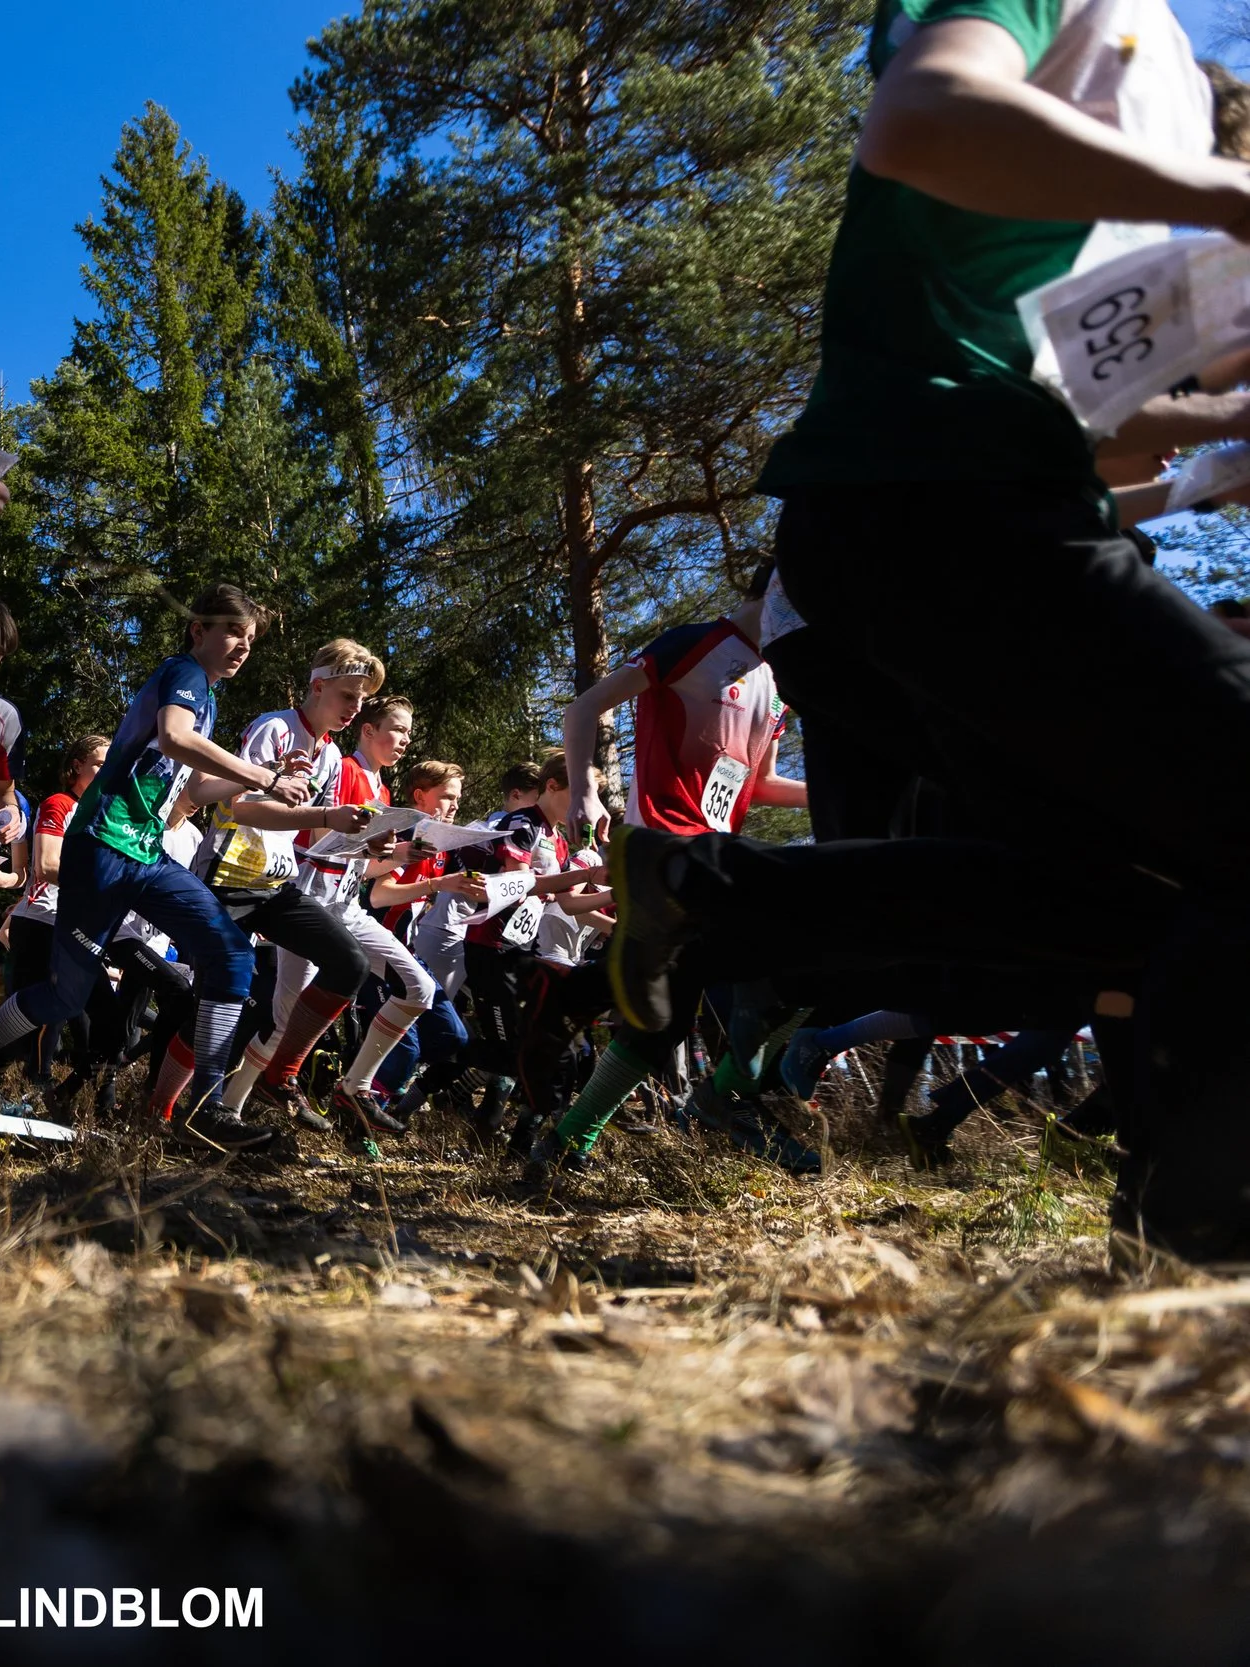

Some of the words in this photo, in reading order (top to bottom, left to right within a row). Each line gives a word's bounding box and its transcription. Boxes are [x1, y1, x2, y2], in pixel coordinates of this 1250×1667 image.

[1079, 286, 1154, 381] 359
[716, 765, 736, 780] NOREX
[706, 780, 734, 822] 356
[121, 823, 140, 839] OK
[266, 851, 293, 880] 367
[500, 880, 525, 897] 365
[513, 908, 536, 940] 364
[134, 950, 157, 971] TRIMTEX
[493, 1005, 507, 1041] TRIMTEX
